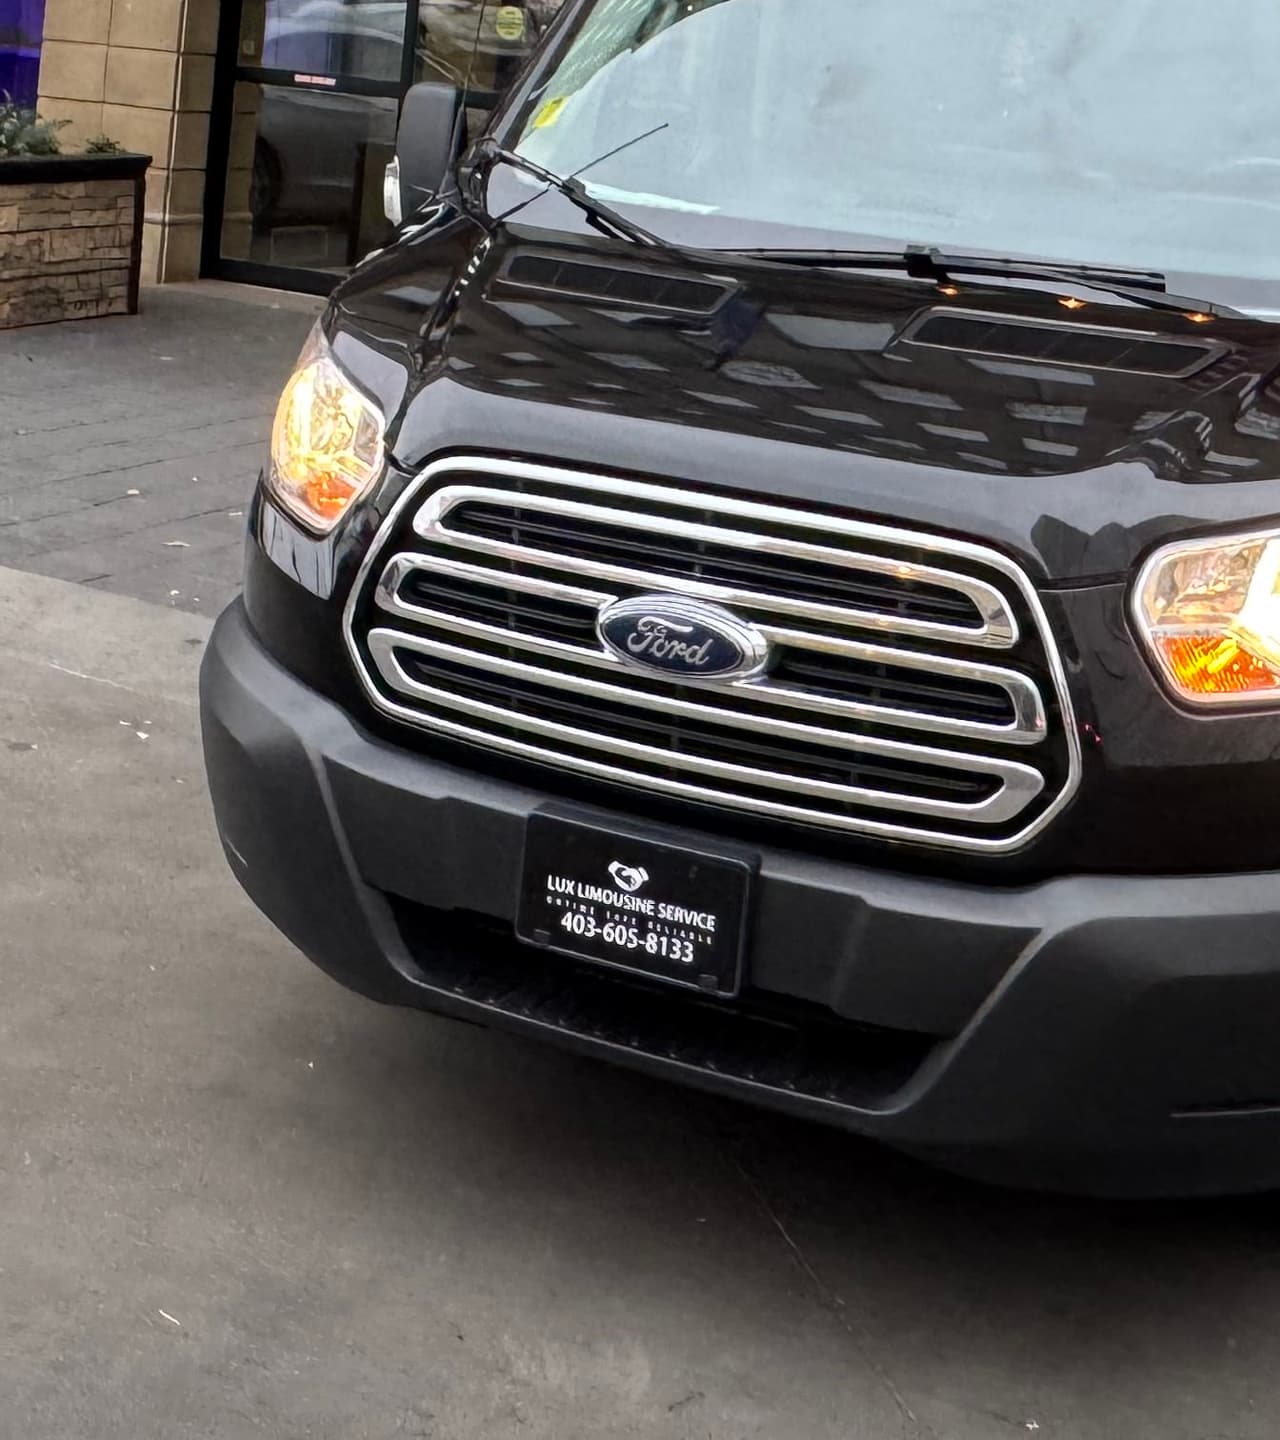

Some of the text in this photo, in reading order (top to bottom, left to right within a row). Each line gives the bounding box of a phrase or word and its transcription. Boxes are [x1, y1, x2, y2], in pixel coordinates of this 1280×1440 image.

[628, 617, 713, 665] Ford
[546, 874, 717, 933] LUX LIMOUSINE SERVICE
[560, 911, 694, 963] 403-605-8133
